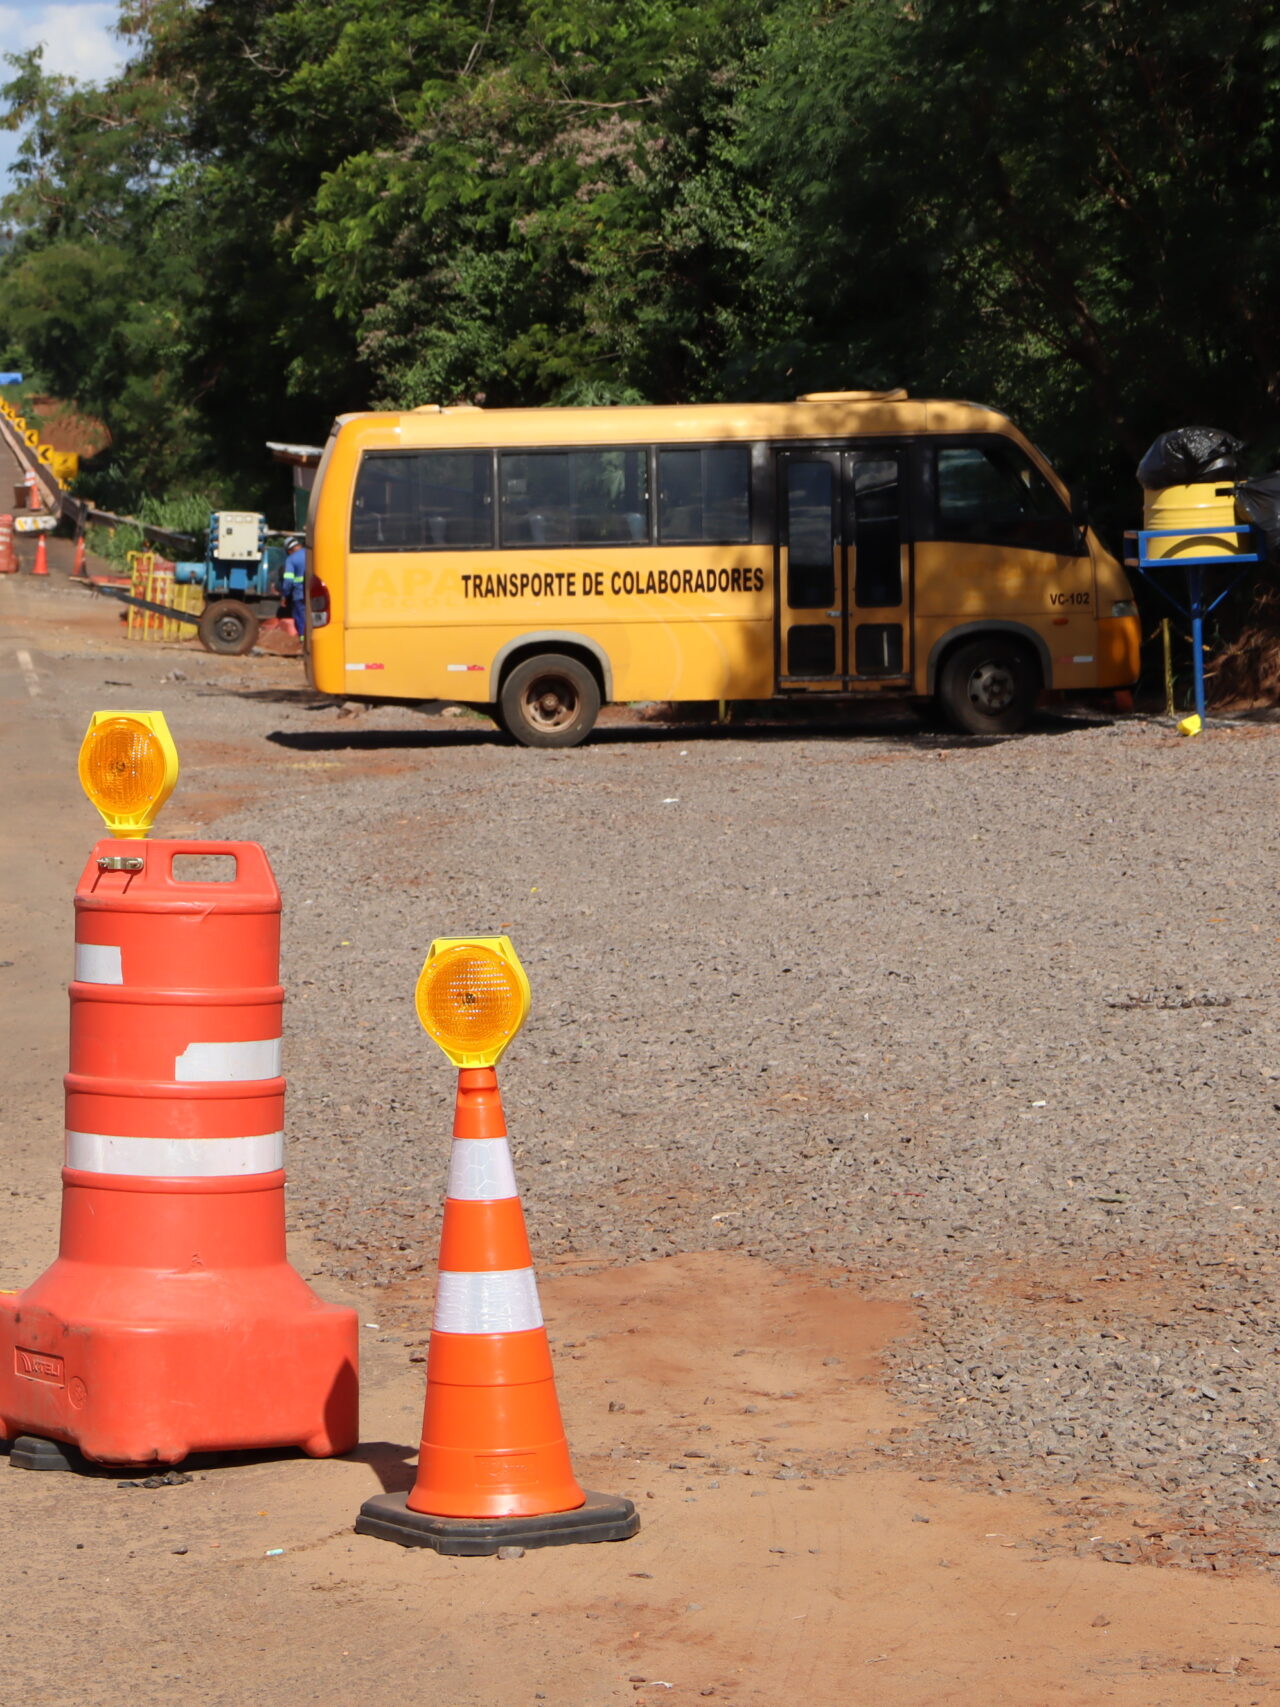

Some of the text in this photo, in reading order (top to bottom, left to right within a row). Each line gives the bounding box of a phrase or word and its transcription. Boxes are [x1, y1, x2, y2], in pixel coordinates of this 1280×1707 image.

[461, 567, 764, 598] TRANSPORTE DE COLABORADORES
[1049, 592, 1090, 605] VC-102
